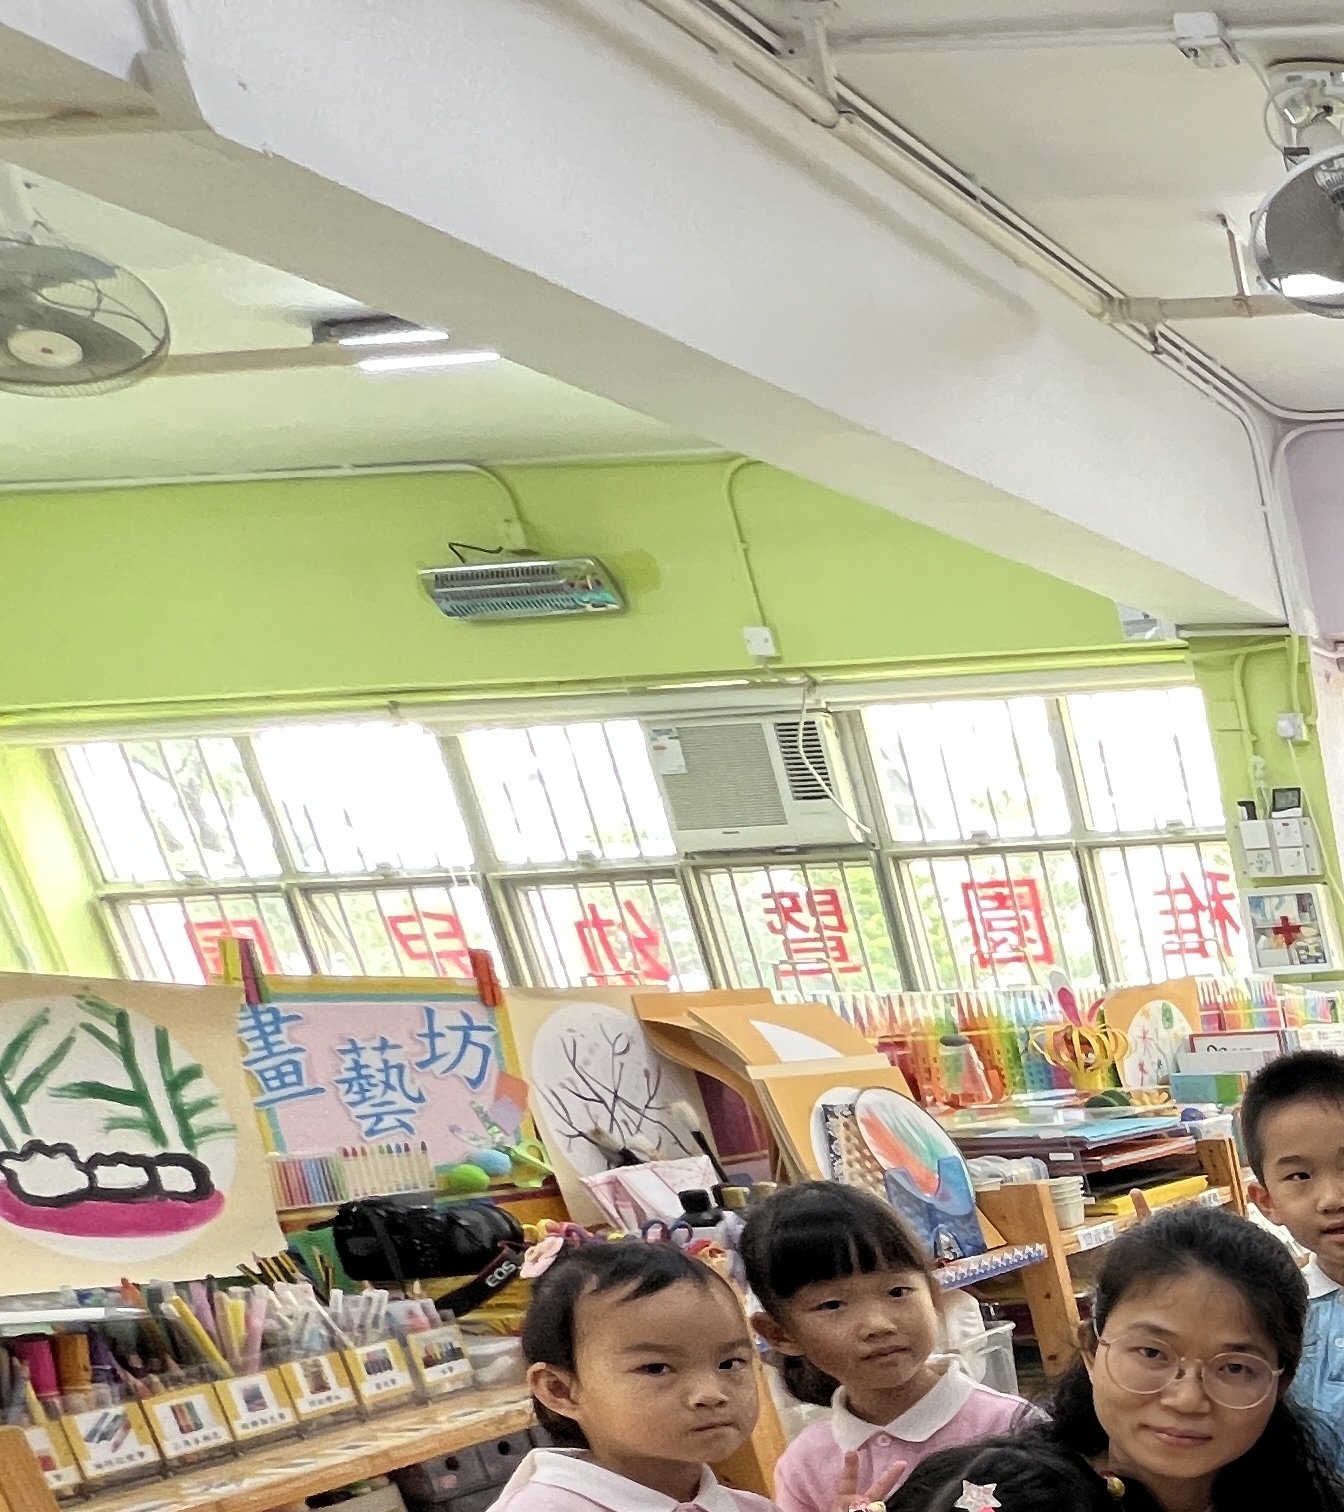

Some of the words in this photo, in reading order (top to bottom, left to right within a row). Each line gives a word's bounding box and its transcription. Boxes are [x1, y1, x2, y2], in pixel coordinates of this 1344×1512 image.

[238, 1003, 498, 1139] 畫藝坊
[485, 1260, 518, 1287] EOS
